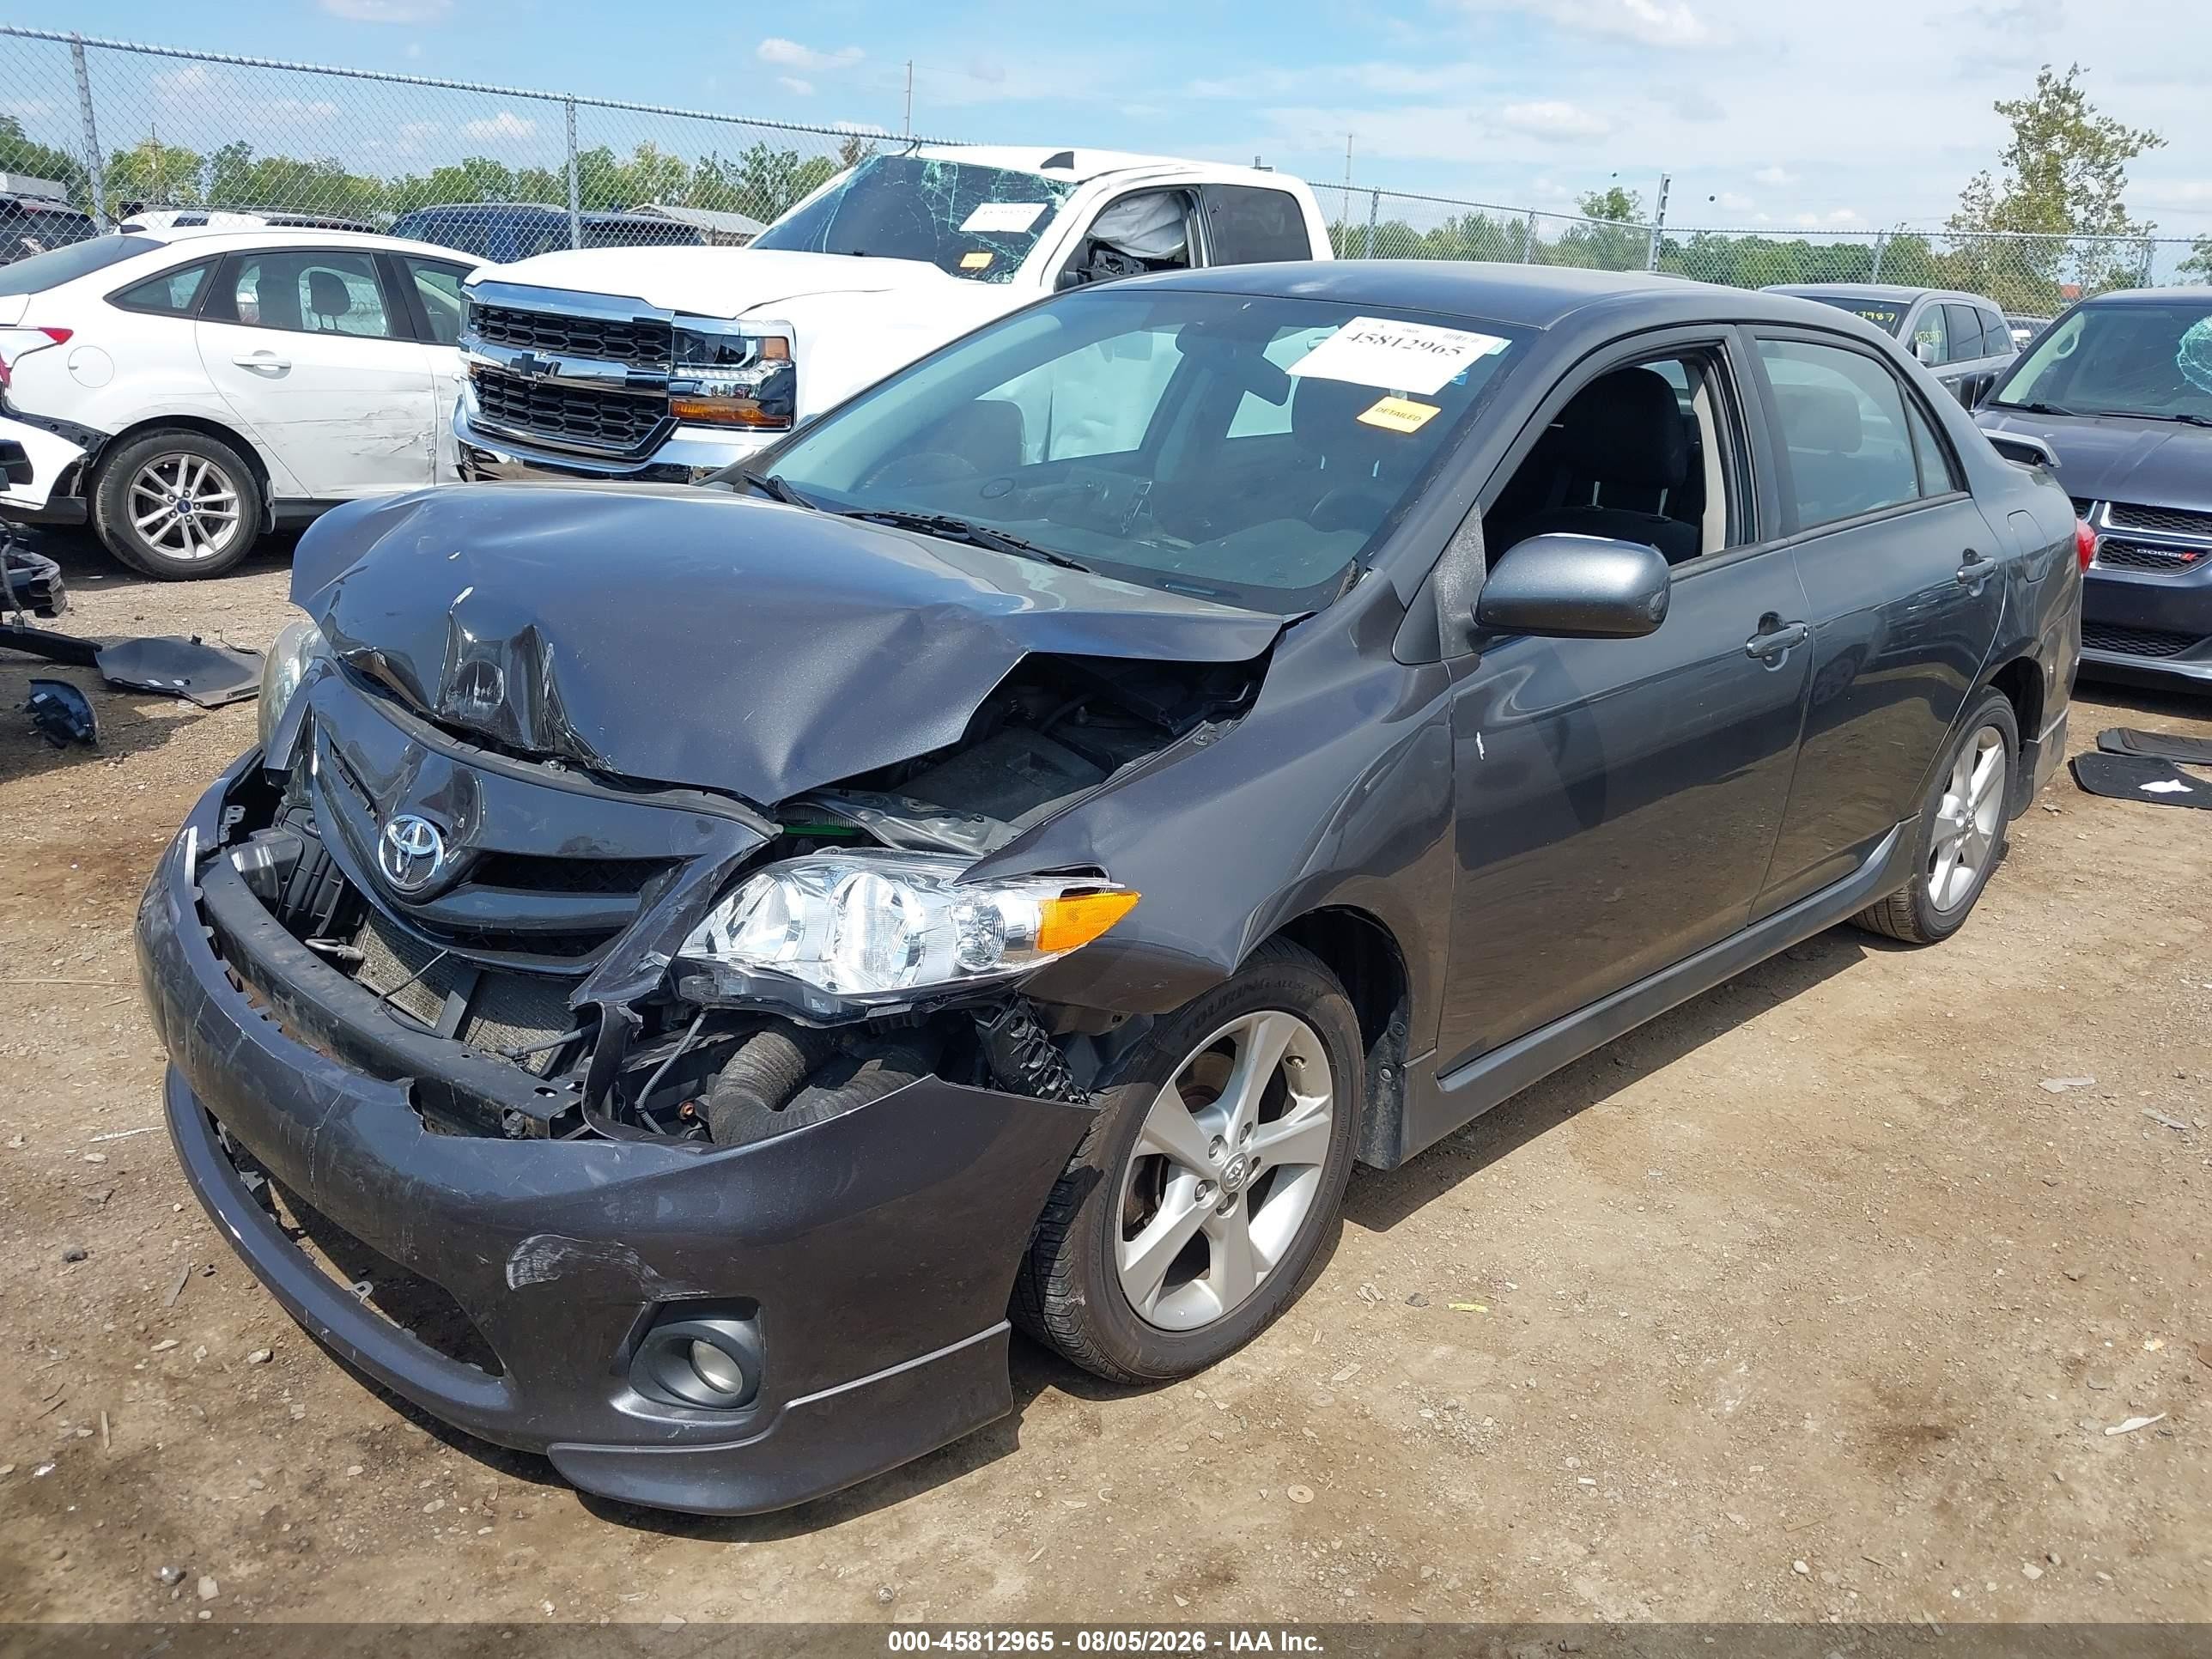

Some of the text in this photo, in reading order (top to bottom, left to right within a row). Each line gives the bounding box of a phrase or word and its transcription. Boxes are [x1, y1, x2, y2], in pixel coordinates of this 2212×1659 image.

[1852, 311, 1895, 323] 3987
[1346, 331, 1466, 356] 45812965
[1375, 406, 1422, 422] DETAILED
